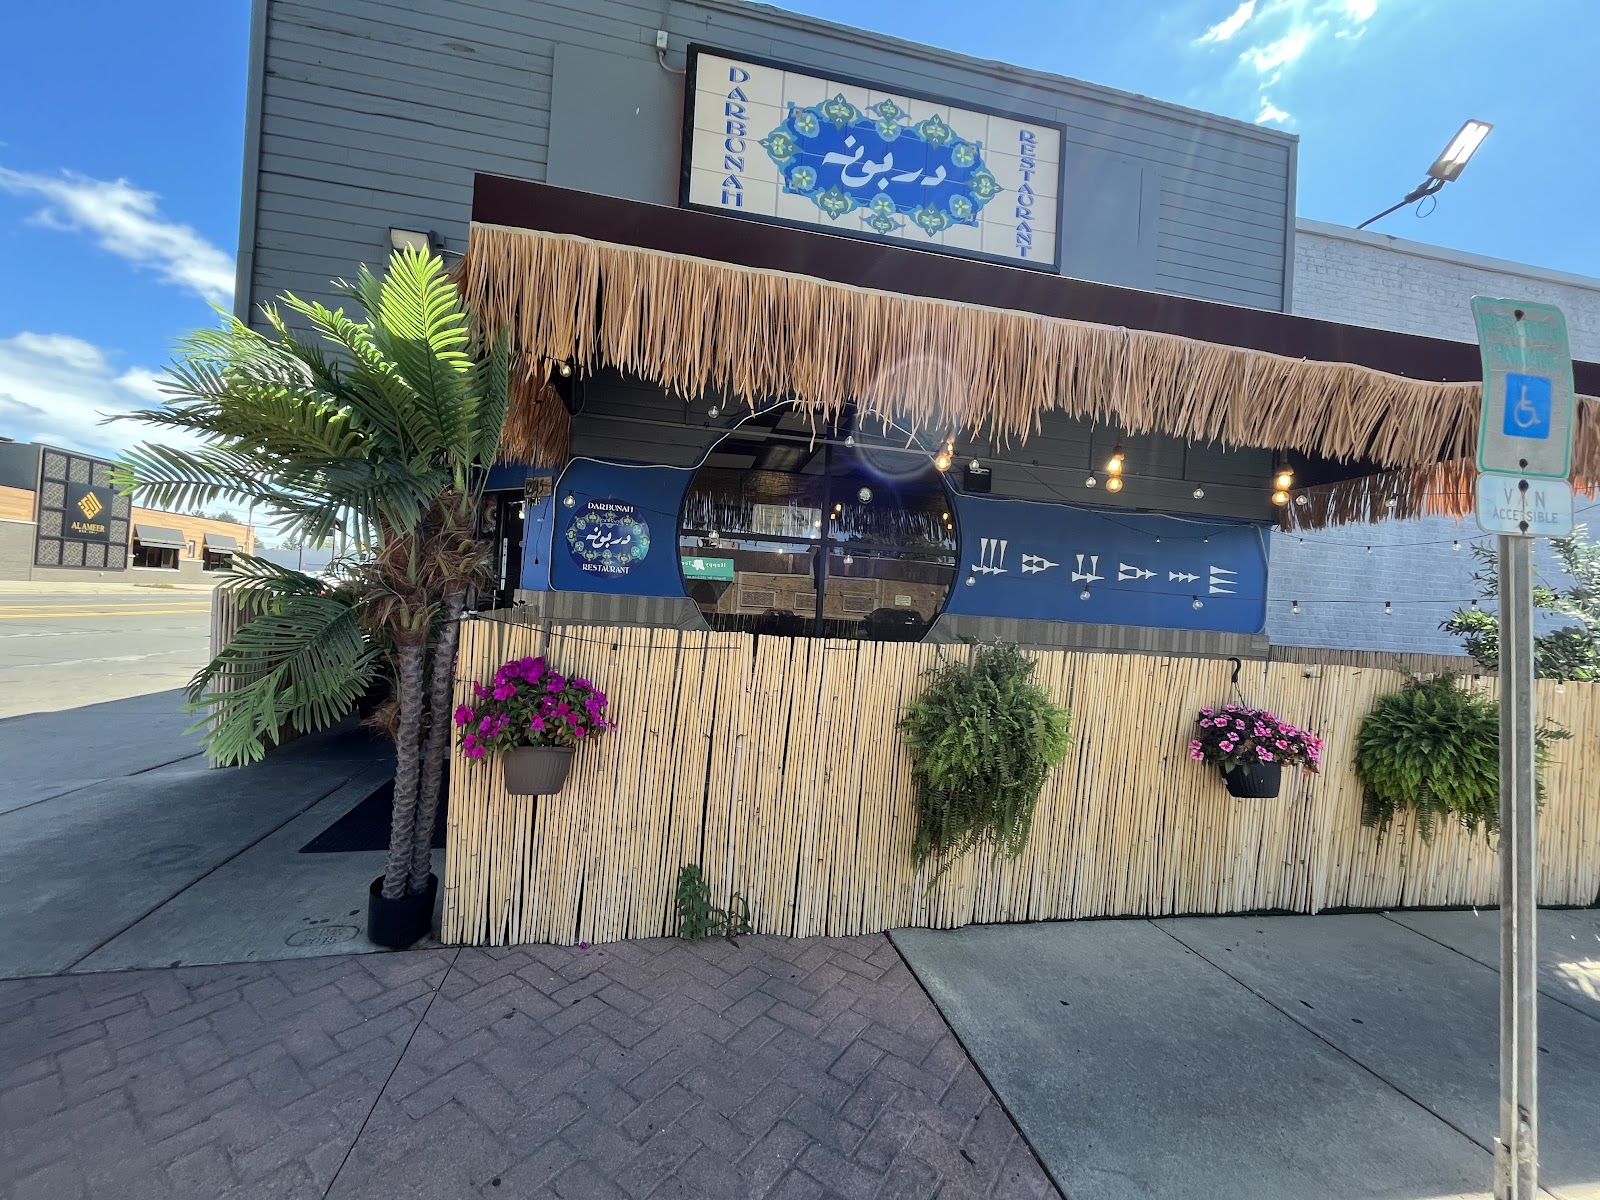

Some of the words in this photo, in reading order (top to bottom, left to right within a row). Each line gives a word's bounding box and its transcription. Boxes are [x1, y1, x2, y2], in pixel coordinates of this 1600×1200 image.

[721, 66, 750, 207] DARBUNAH
[1015, 129, 1036, 257] RESTAURANT
[587, 502, 634, 513] DARBUNAH
[1493, 506, 1558, 524] ACCESIBLE
[81, 523, 105, 533] AMEER
[582, 563, 630, 574] RESTAURANT
